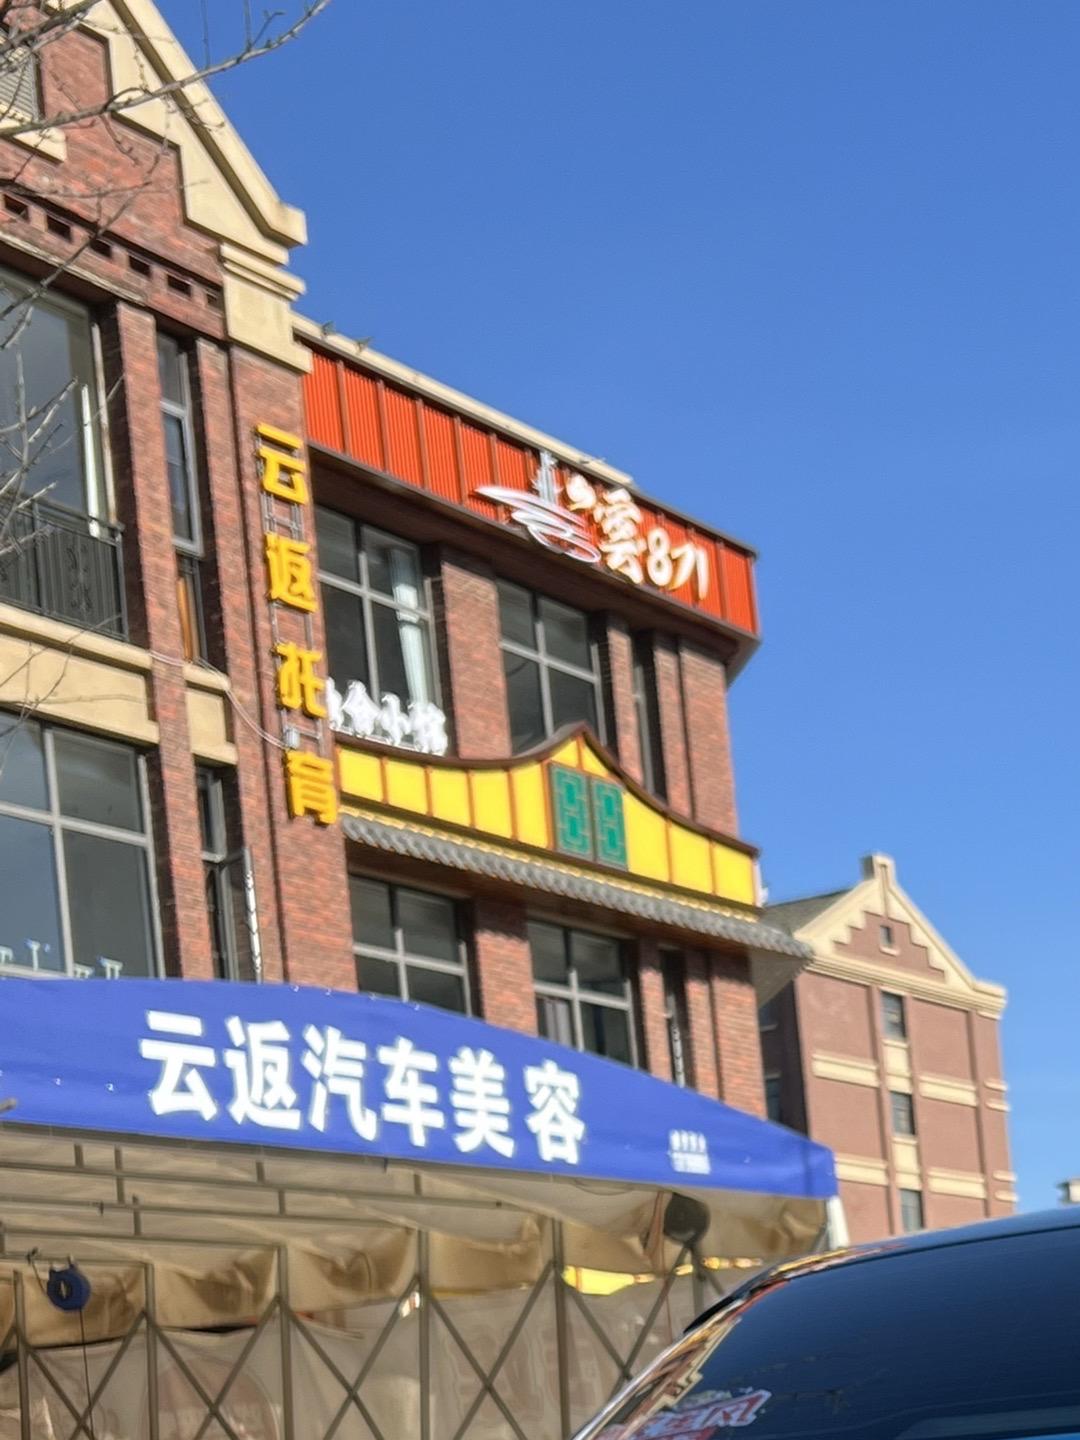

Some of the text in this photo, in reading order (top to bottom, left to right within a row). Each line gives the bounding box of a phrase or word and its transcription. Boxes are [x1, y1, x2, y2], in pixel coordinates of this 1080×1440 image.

[255, 423, 340, 826] 云返托育
[138, 1010, 588, 1165] 云返汽车美容
